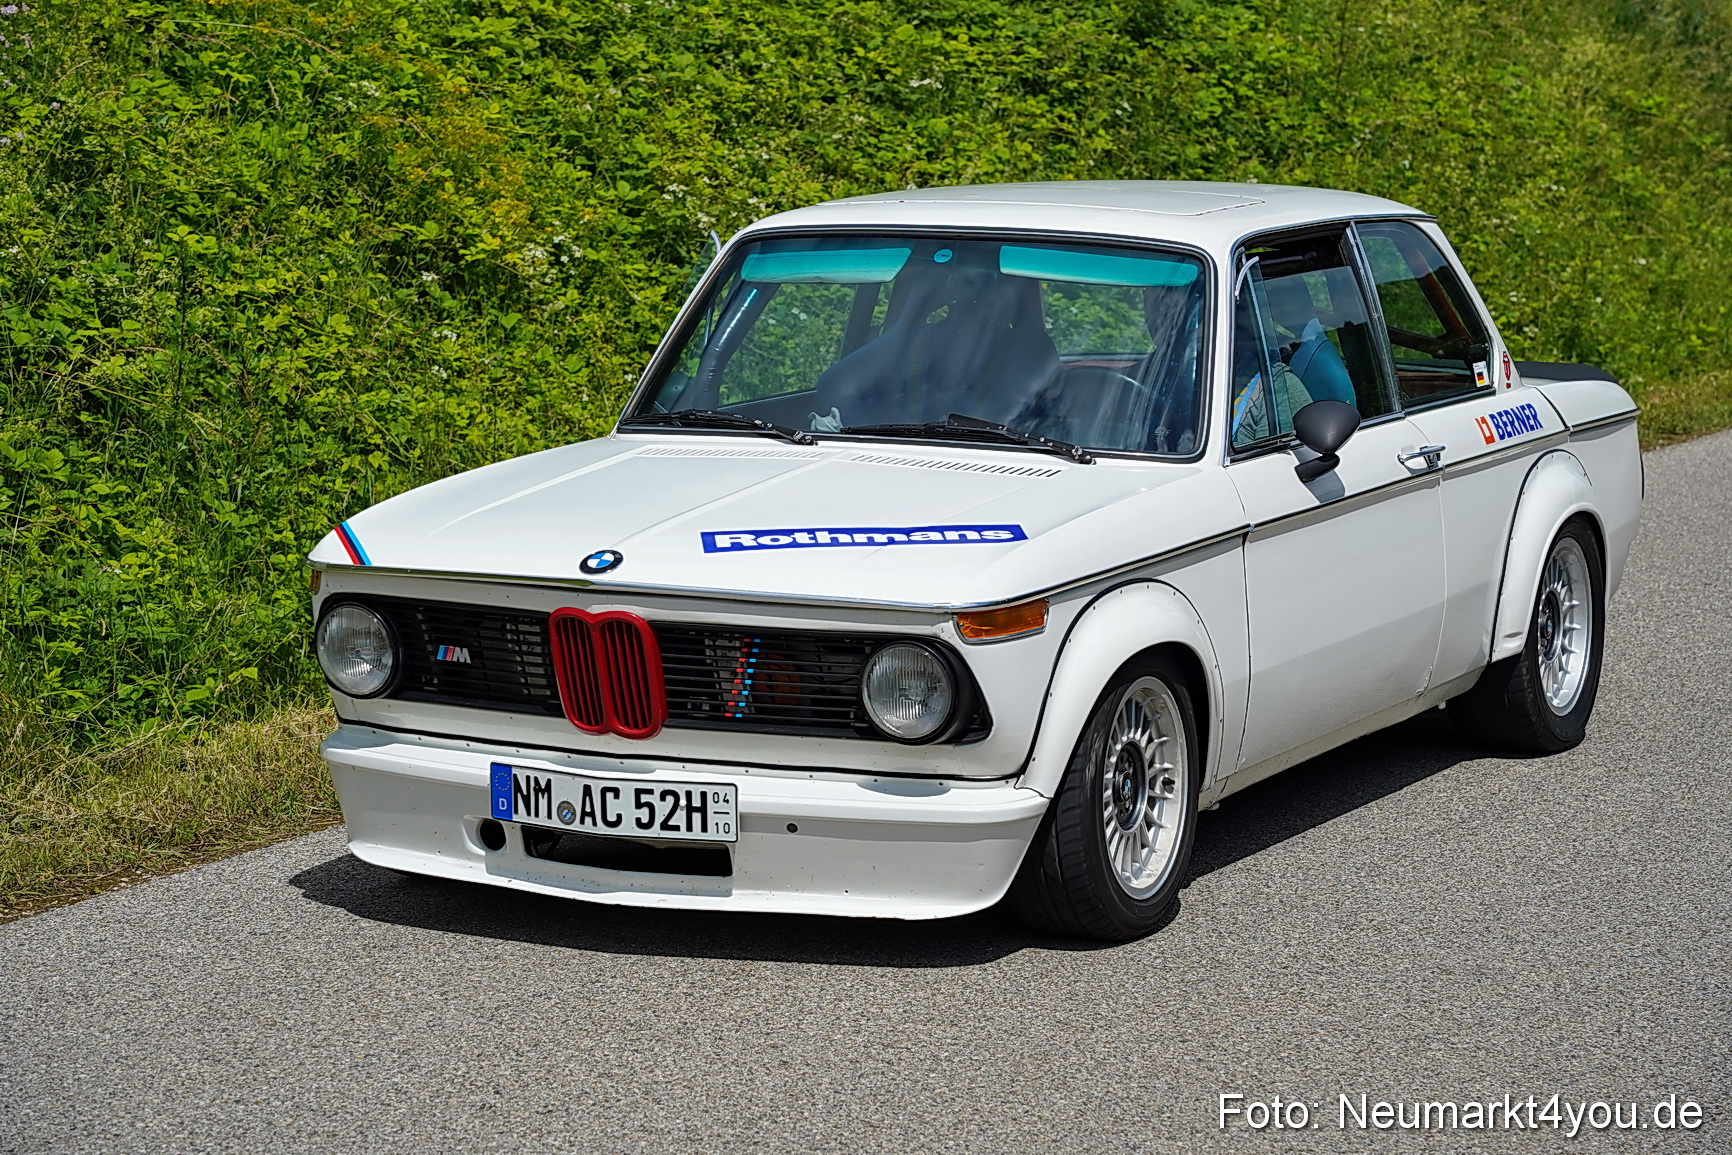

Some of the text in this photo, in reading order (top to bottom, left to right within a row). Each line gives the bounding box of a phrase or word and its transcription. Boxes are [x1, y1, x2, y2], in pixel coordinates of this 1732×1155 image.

[1488, 403, 1543, 440] BERNER
[714, 530, 1015, 548] Rothmans
[499, 798, 508, 810] D
[513, 773, 709, 834] NM AC 52H
[713, 791, 730, 804] 04
[714, 821, 731, 835] 10
